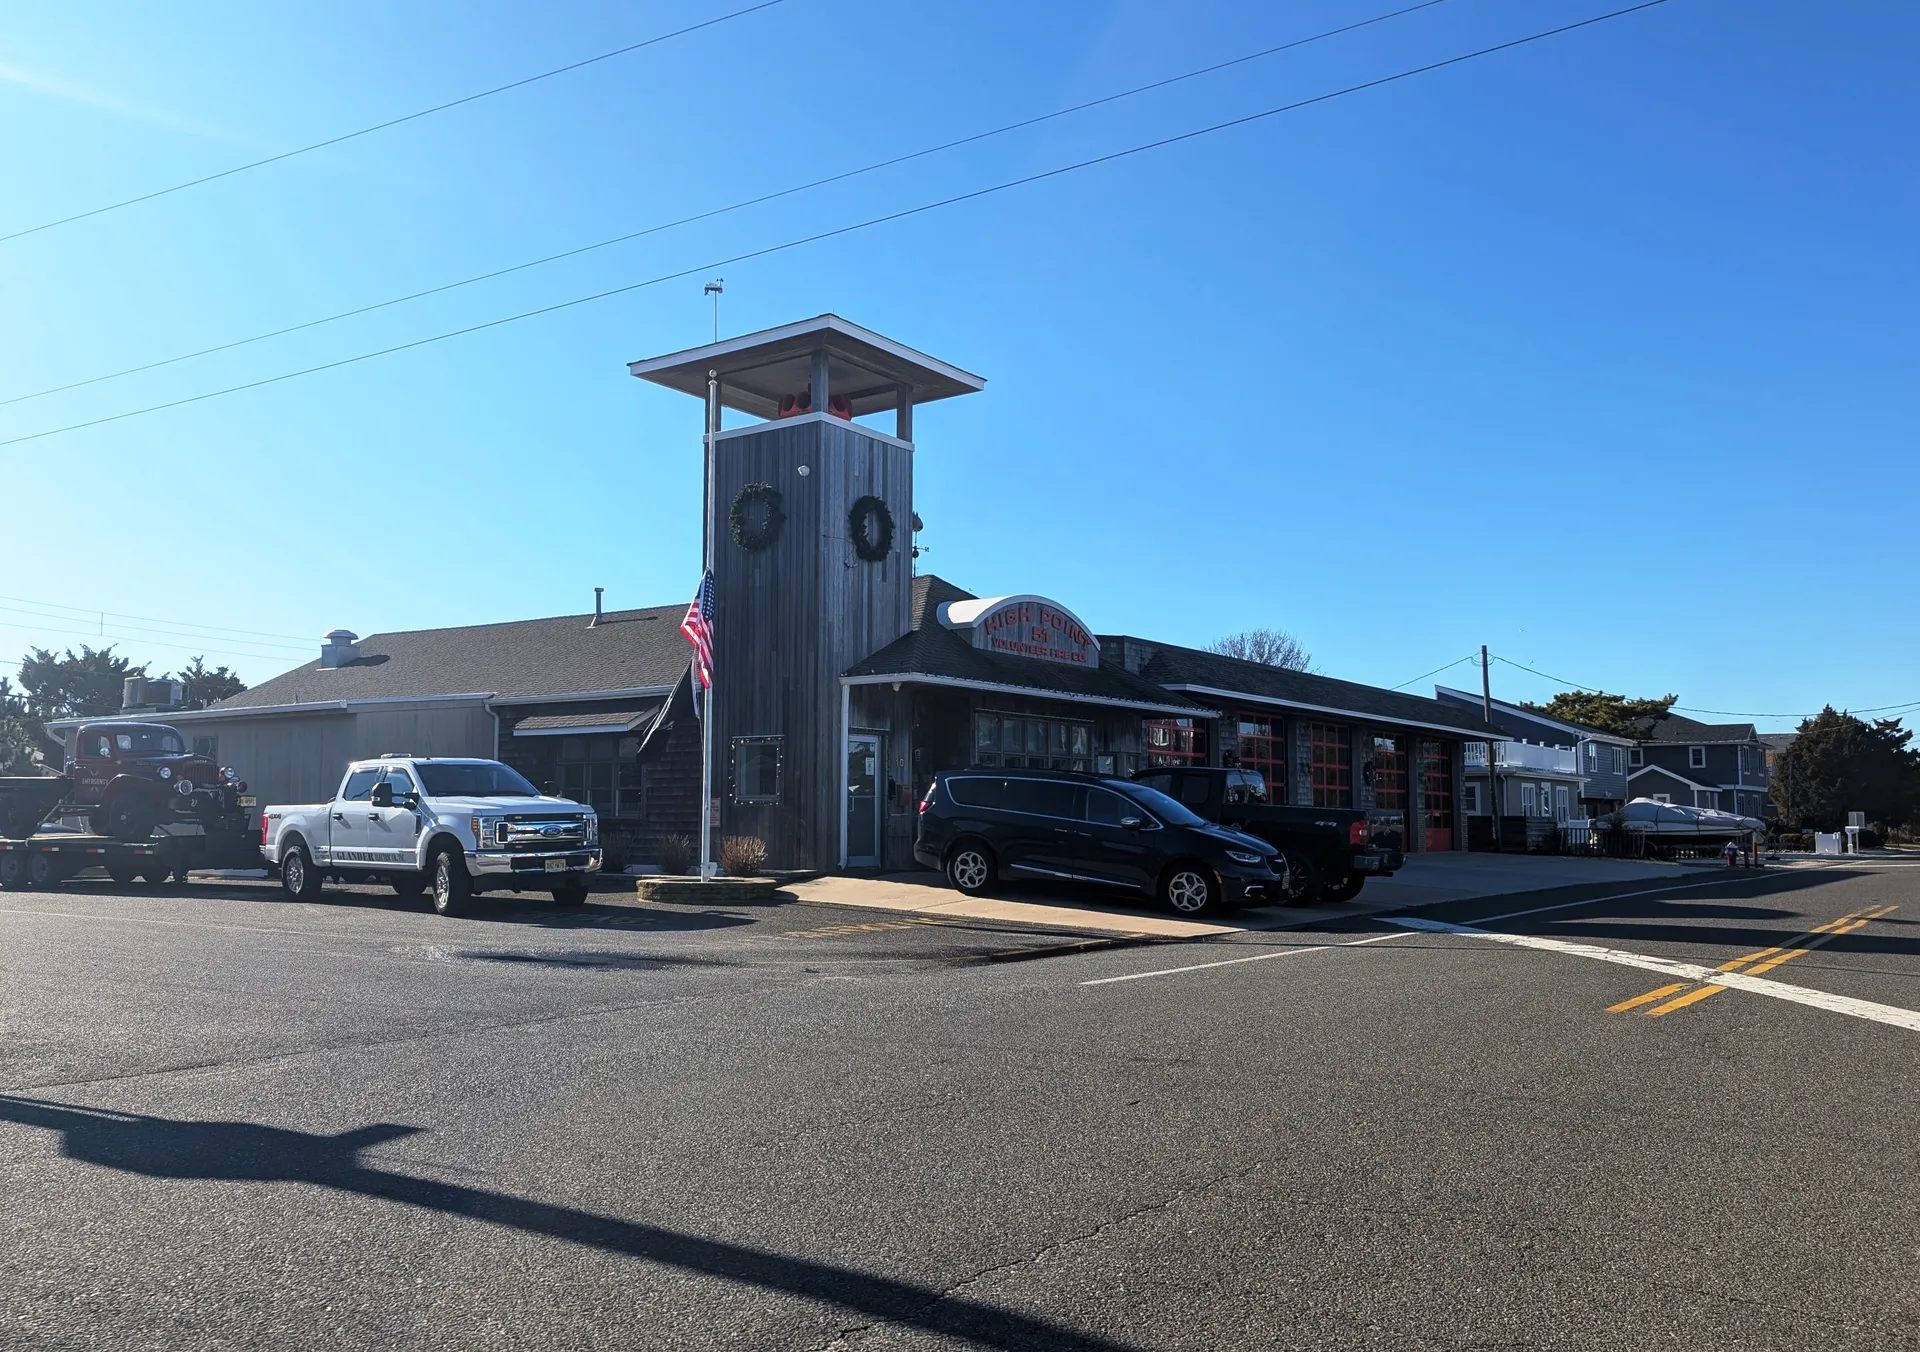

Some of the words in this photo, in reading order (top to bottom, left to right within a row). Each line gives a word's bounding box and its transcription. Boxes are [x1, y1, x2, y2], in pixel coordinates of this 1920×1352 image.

[985, 607, 1031, 635] HIGH
[1041, 607, 1092, 651] POINT
[1032, 626, 1050, 643] 51
[991, 636, 1048, 656] VOLUNTEER
[1050, 648, 1071, 660] FIRE
[82, 777, 109, 786] EMERGENCY
[336, 851, 375, 862] GLANDER
